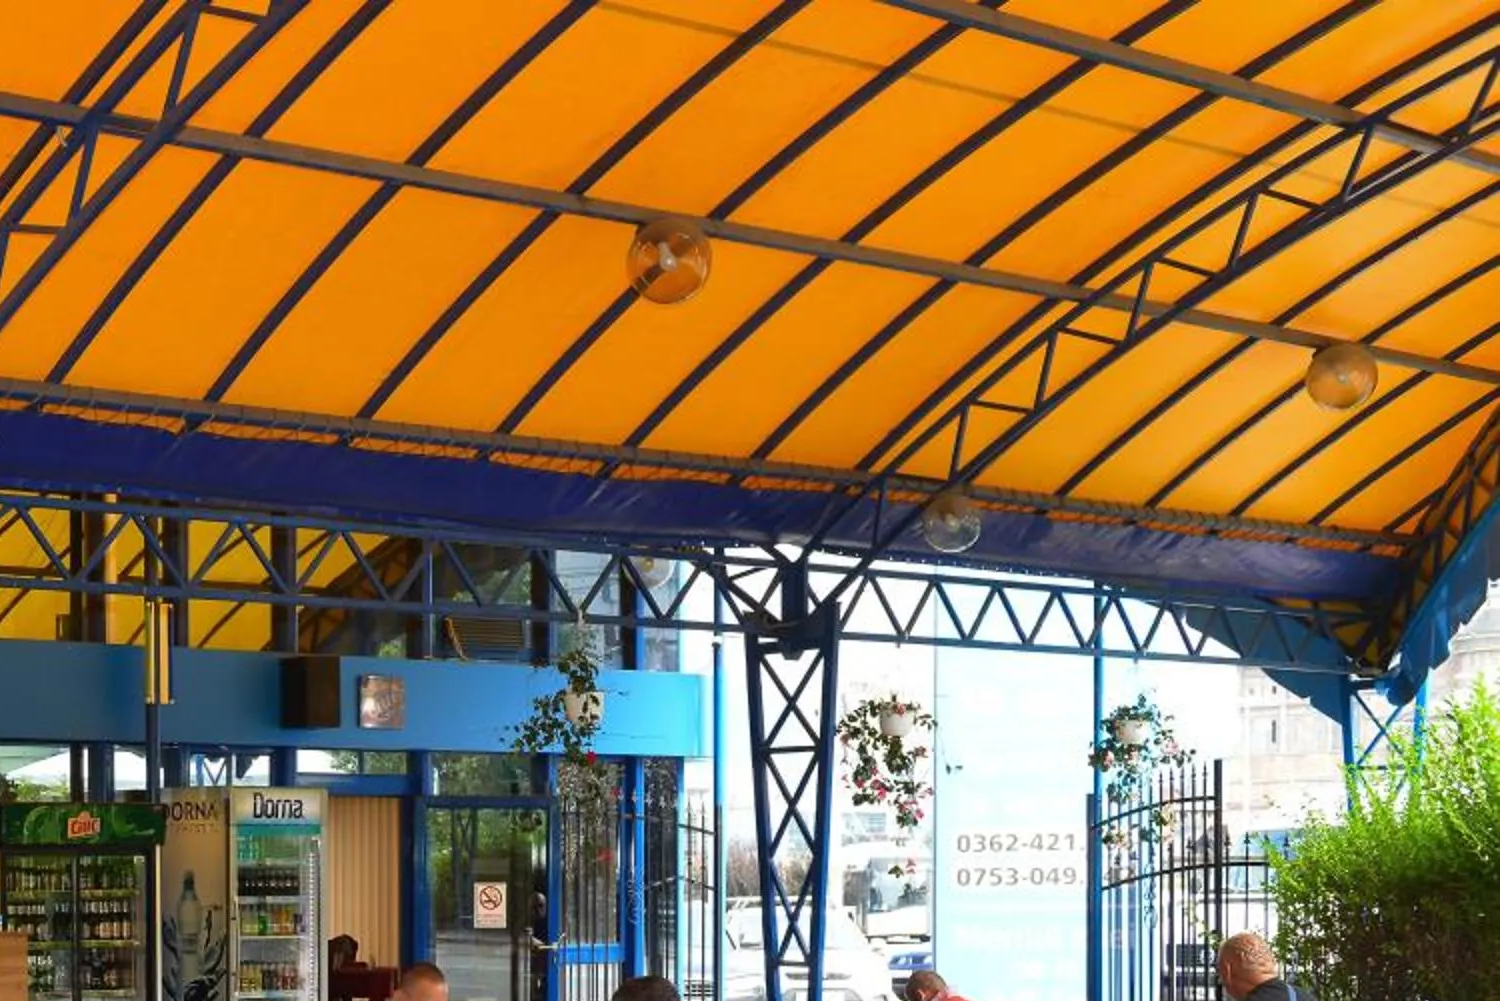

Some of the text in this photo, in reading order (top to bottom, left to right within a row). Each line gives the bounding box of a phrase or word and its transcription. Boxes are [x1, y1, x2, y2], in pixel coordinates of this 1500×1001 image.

[253, 791, 303, 818] Dorna
[957, 833, 1085, 852] 0362-421.
[957, 867, 1085, 886] 0753-049.
